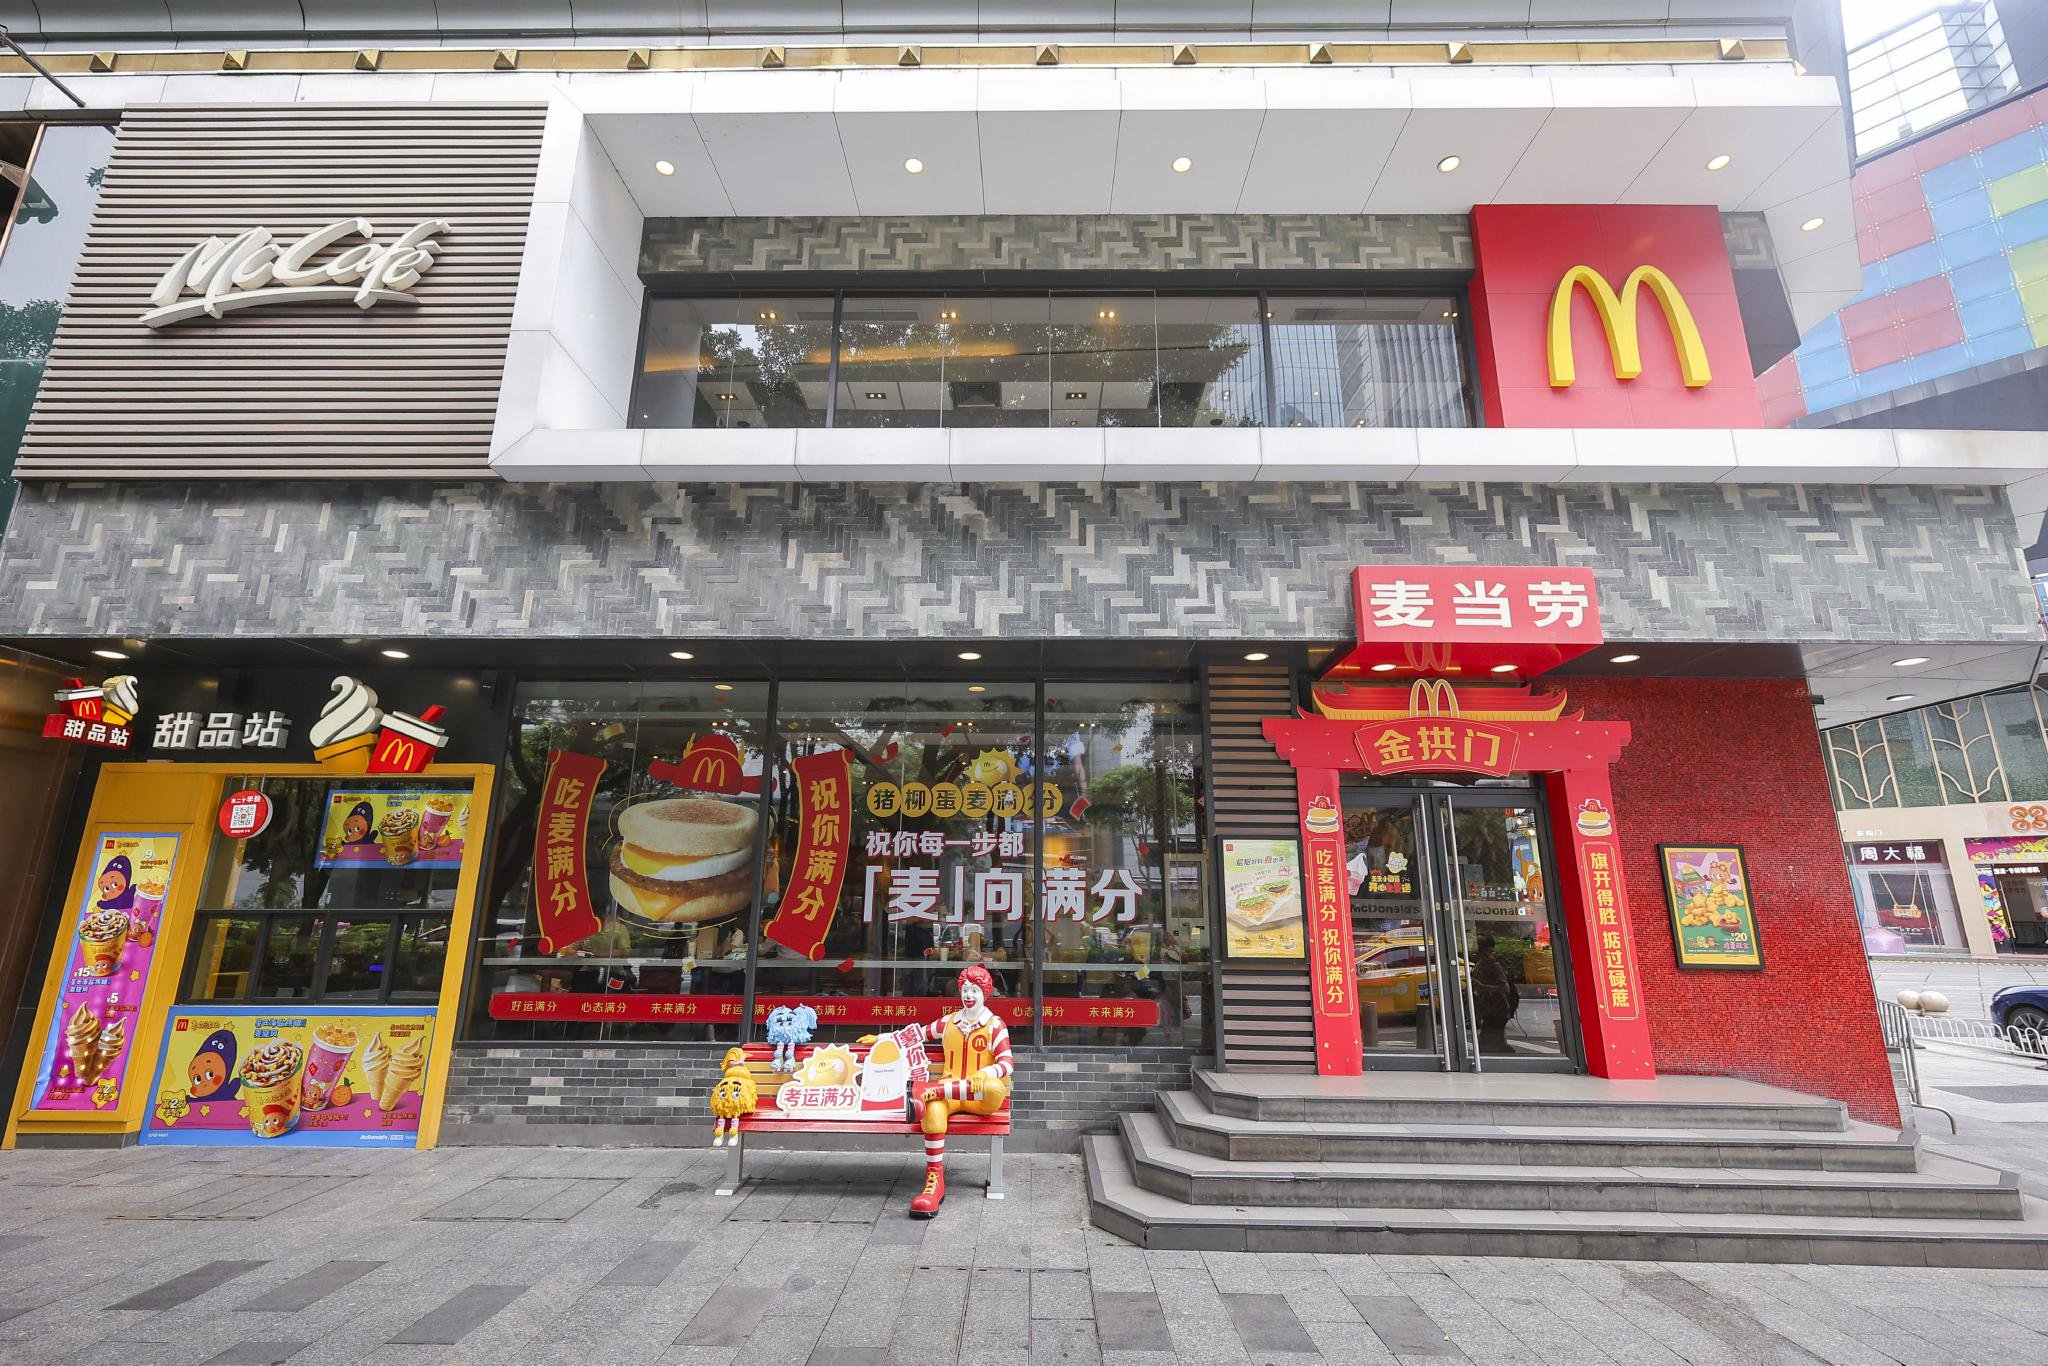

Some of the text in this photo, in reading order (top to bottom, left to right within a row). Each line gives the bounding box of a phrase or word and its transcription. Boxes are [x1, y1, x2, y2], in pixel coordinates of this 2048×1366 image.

[146, 216, 452, 320] McCafé
[1369, 580, 1590, 629] 麦当劳
[63, 718, 130, 747] 甜品站
[152, 711, 286, 749] 甜品站
[1373, 726, 1501, 768] 金拱门
[873, 788, 1057, 811] 猪柳蛋麦满分
[546, 776, 585, 918] 吃麦满分
[791, 777, 841, 922] 祝你满分
[865, 830, 1024, 858] 祝你每一步都
[1860, 845, 1926, 861] 周大福
[1590, 852, 1618, 926] 旗开得胜
[1315, 849, 1345, 1004] 吃麦满分 祝你满分
[511, 1000, 557, 1012] 好运满分
[581, 1001, 628, 1013] 心态满分
[650, 1002, 697, 1014] 未来满分
[813, 1004, 848, 1016] 态满分
[871, 1005, 917, 1017] 未来满分
[1012, 1006, 1065, 1017] 心态满分
[1088, 1006, 1135, 1018] 未来满分
[783, 1087, 858, 1108] 考运满分
